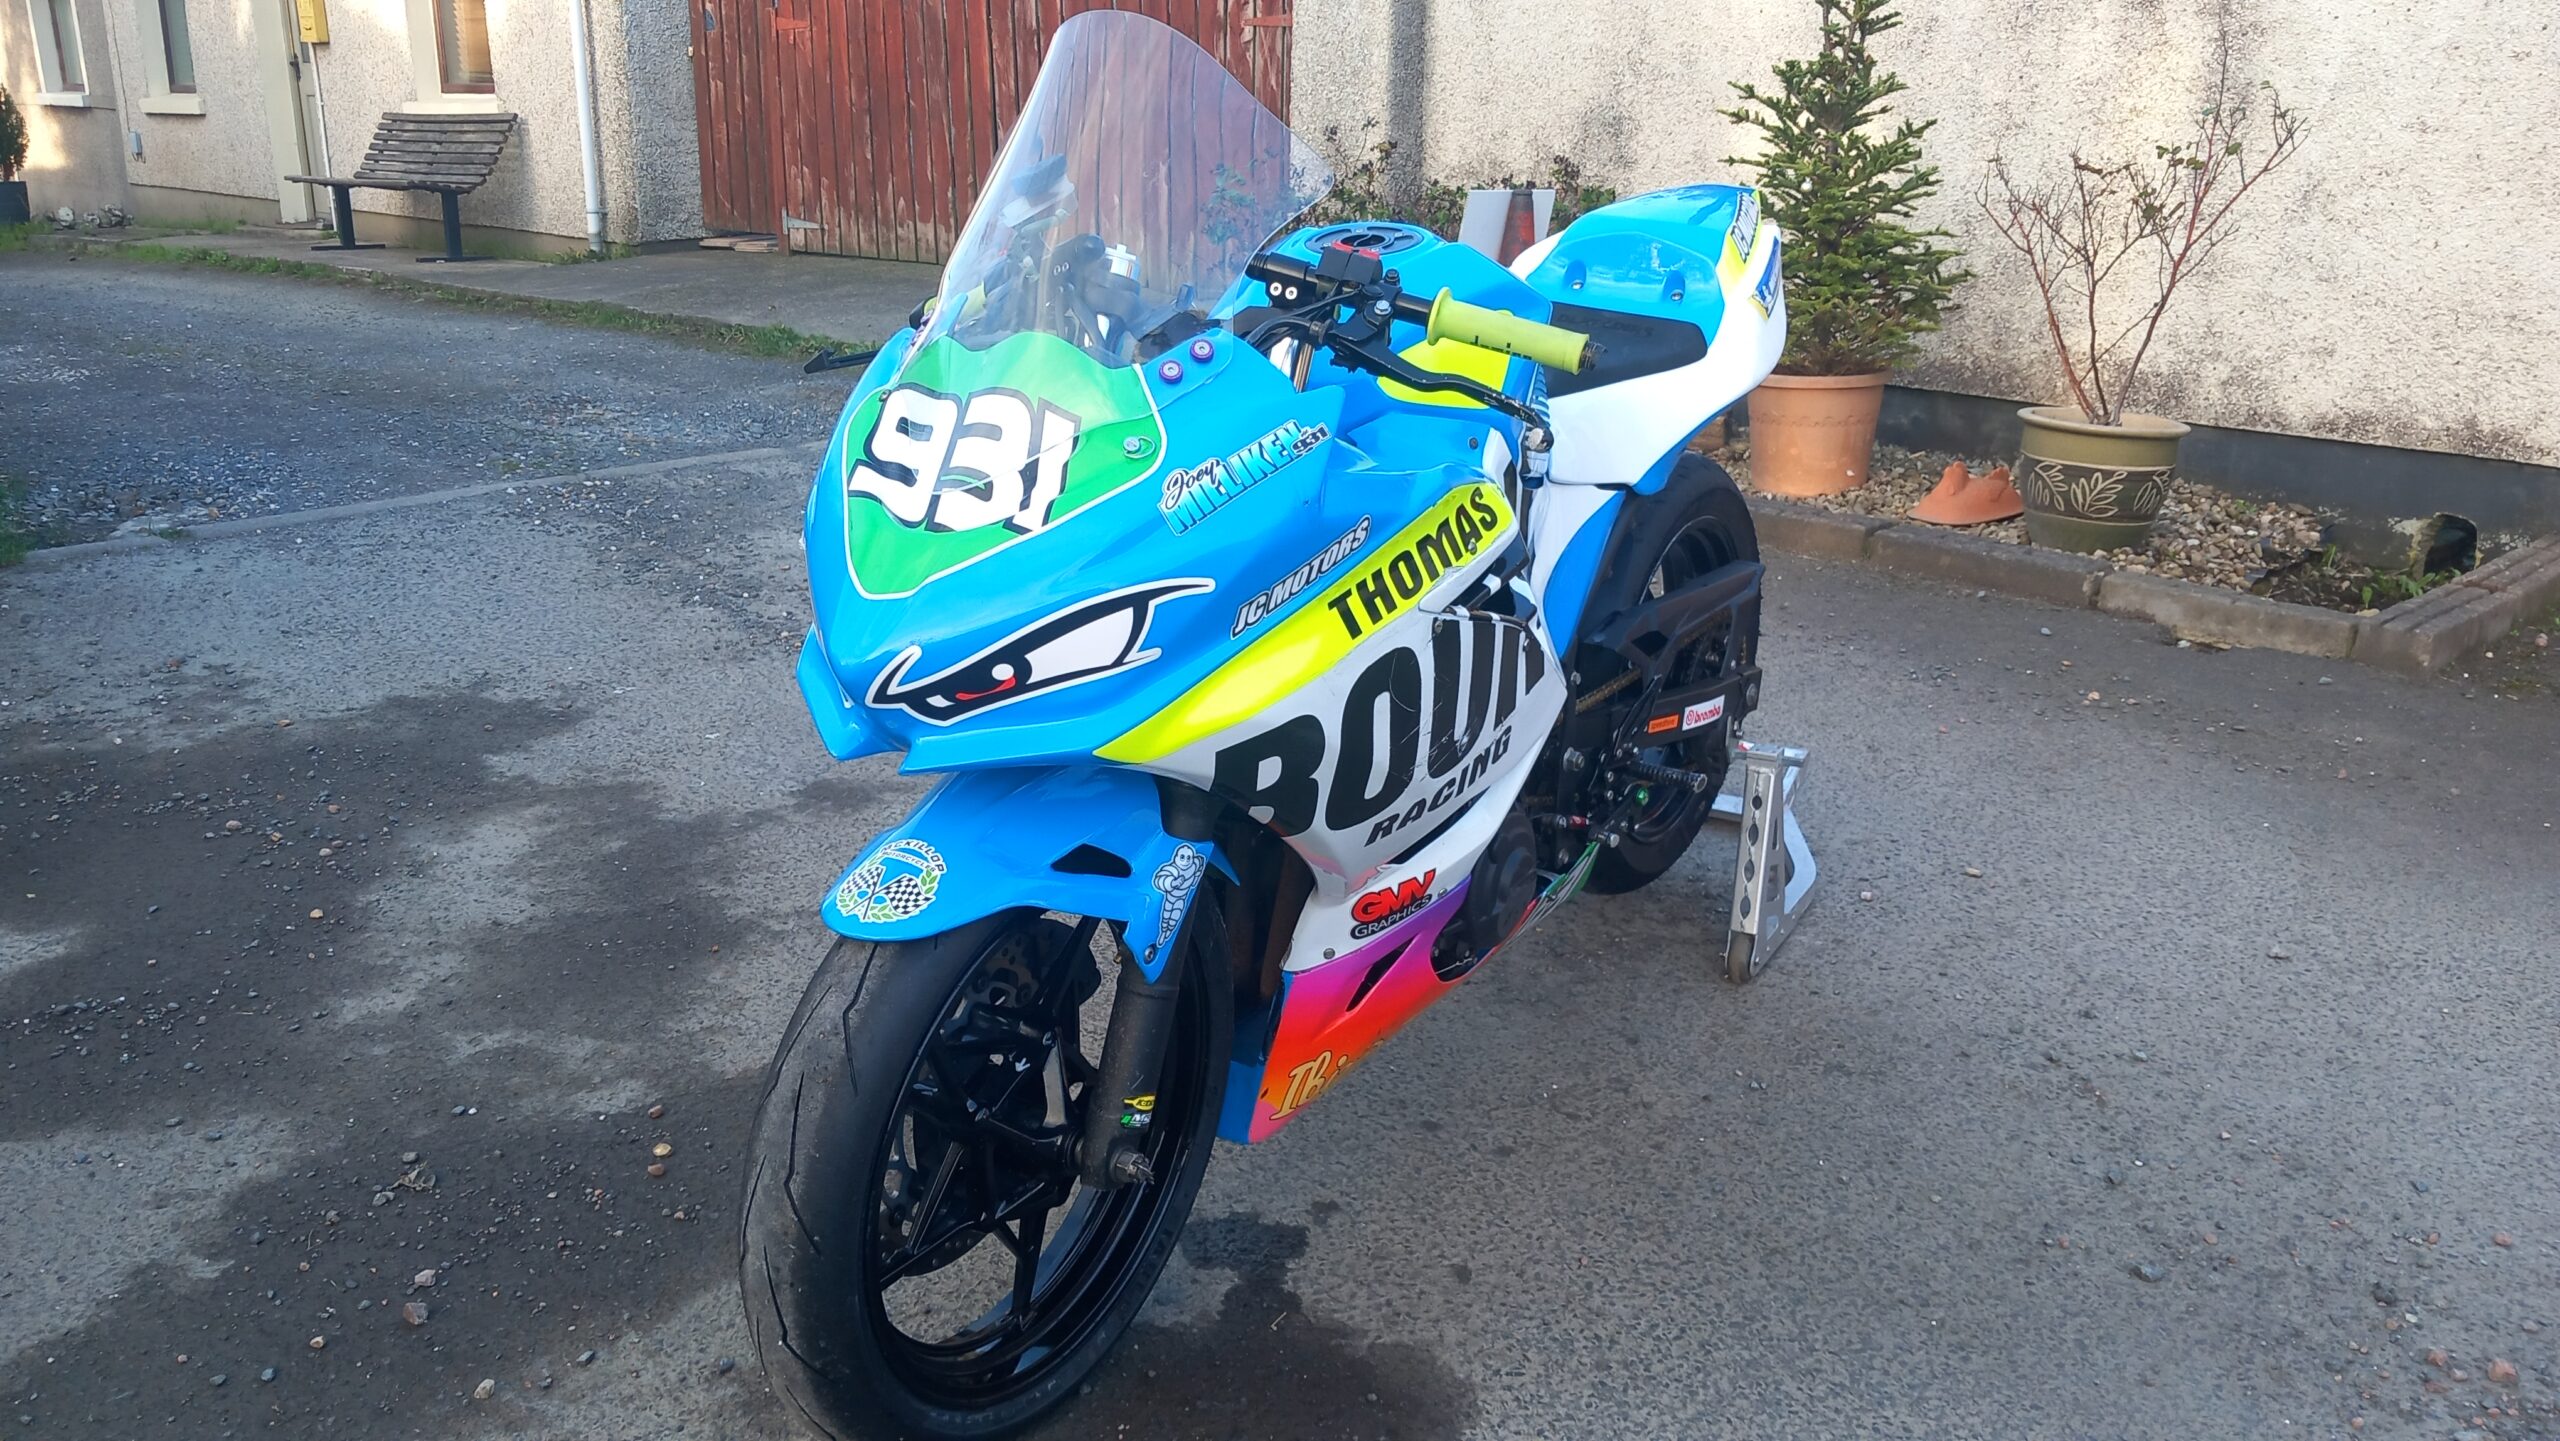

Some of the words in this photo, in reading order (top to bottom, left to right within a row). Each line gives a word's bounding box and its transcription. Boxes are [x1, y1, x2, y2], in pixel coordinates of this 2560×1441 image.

[848, 383, 1082, 534] 931
[1165, 459, 1220, 510] Joey
[1292, 426, 1329, 453] 931
[1232, 592, 1269, 638] JC
[1266, 517, 1370, 613] MOTORS
[1328, 487, 1499, 640] THOMAS
[1363, 725, 1512, 847] RACING
[1354, 895, 1430, 937] GRAPHICS
